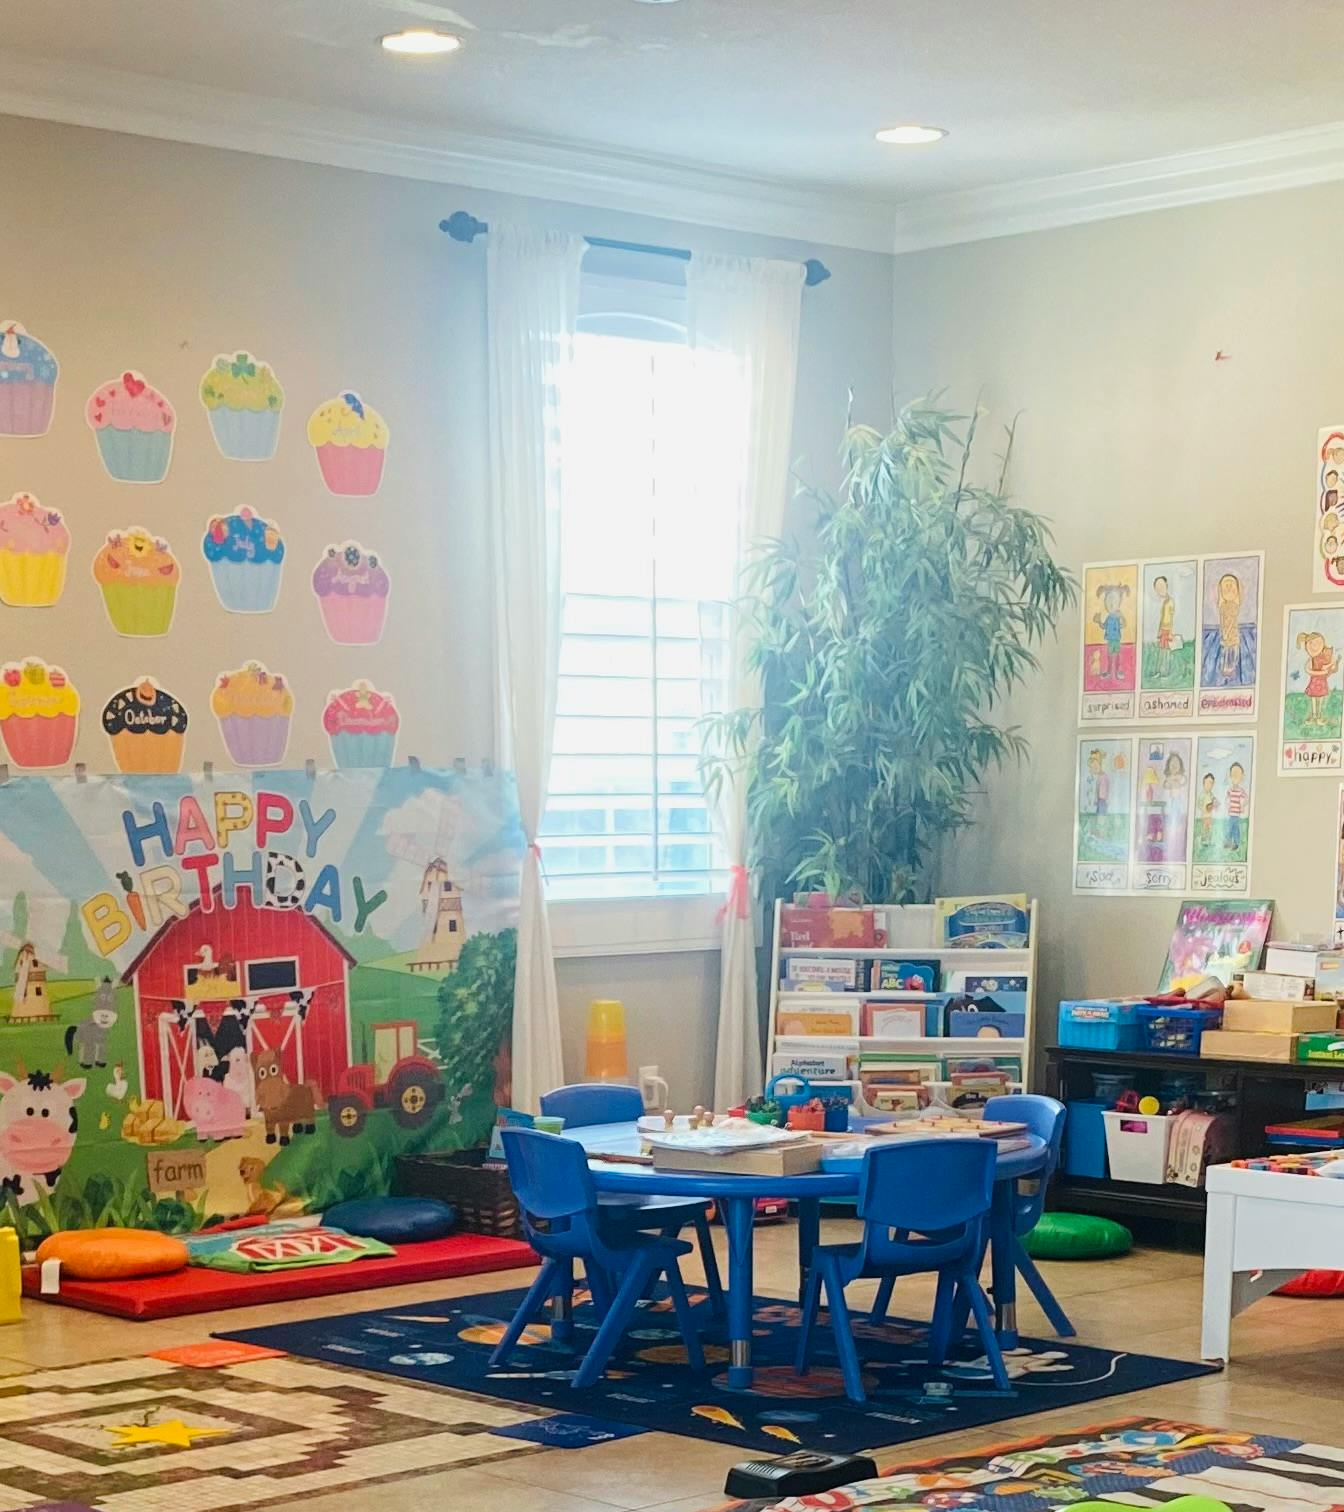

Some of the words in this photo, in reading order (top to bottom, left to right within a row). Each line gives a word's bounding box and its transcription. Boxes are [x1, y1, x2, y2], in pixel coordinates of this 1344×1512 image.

[233, 534, 256, 559] July
[1087, 702, 1130, 715] surprised
[1143, 694, 1189, 710] ashamed
[124, 709, 167, 725] October
[1294, 747, 1332, 763] happy
[122, 791, 336, 866] HAPPY
[81, 851, 388, 957] BIRTHDAY
[881, 979, 904, 989] ABC
[153, 1158, 204, 1185] farm
